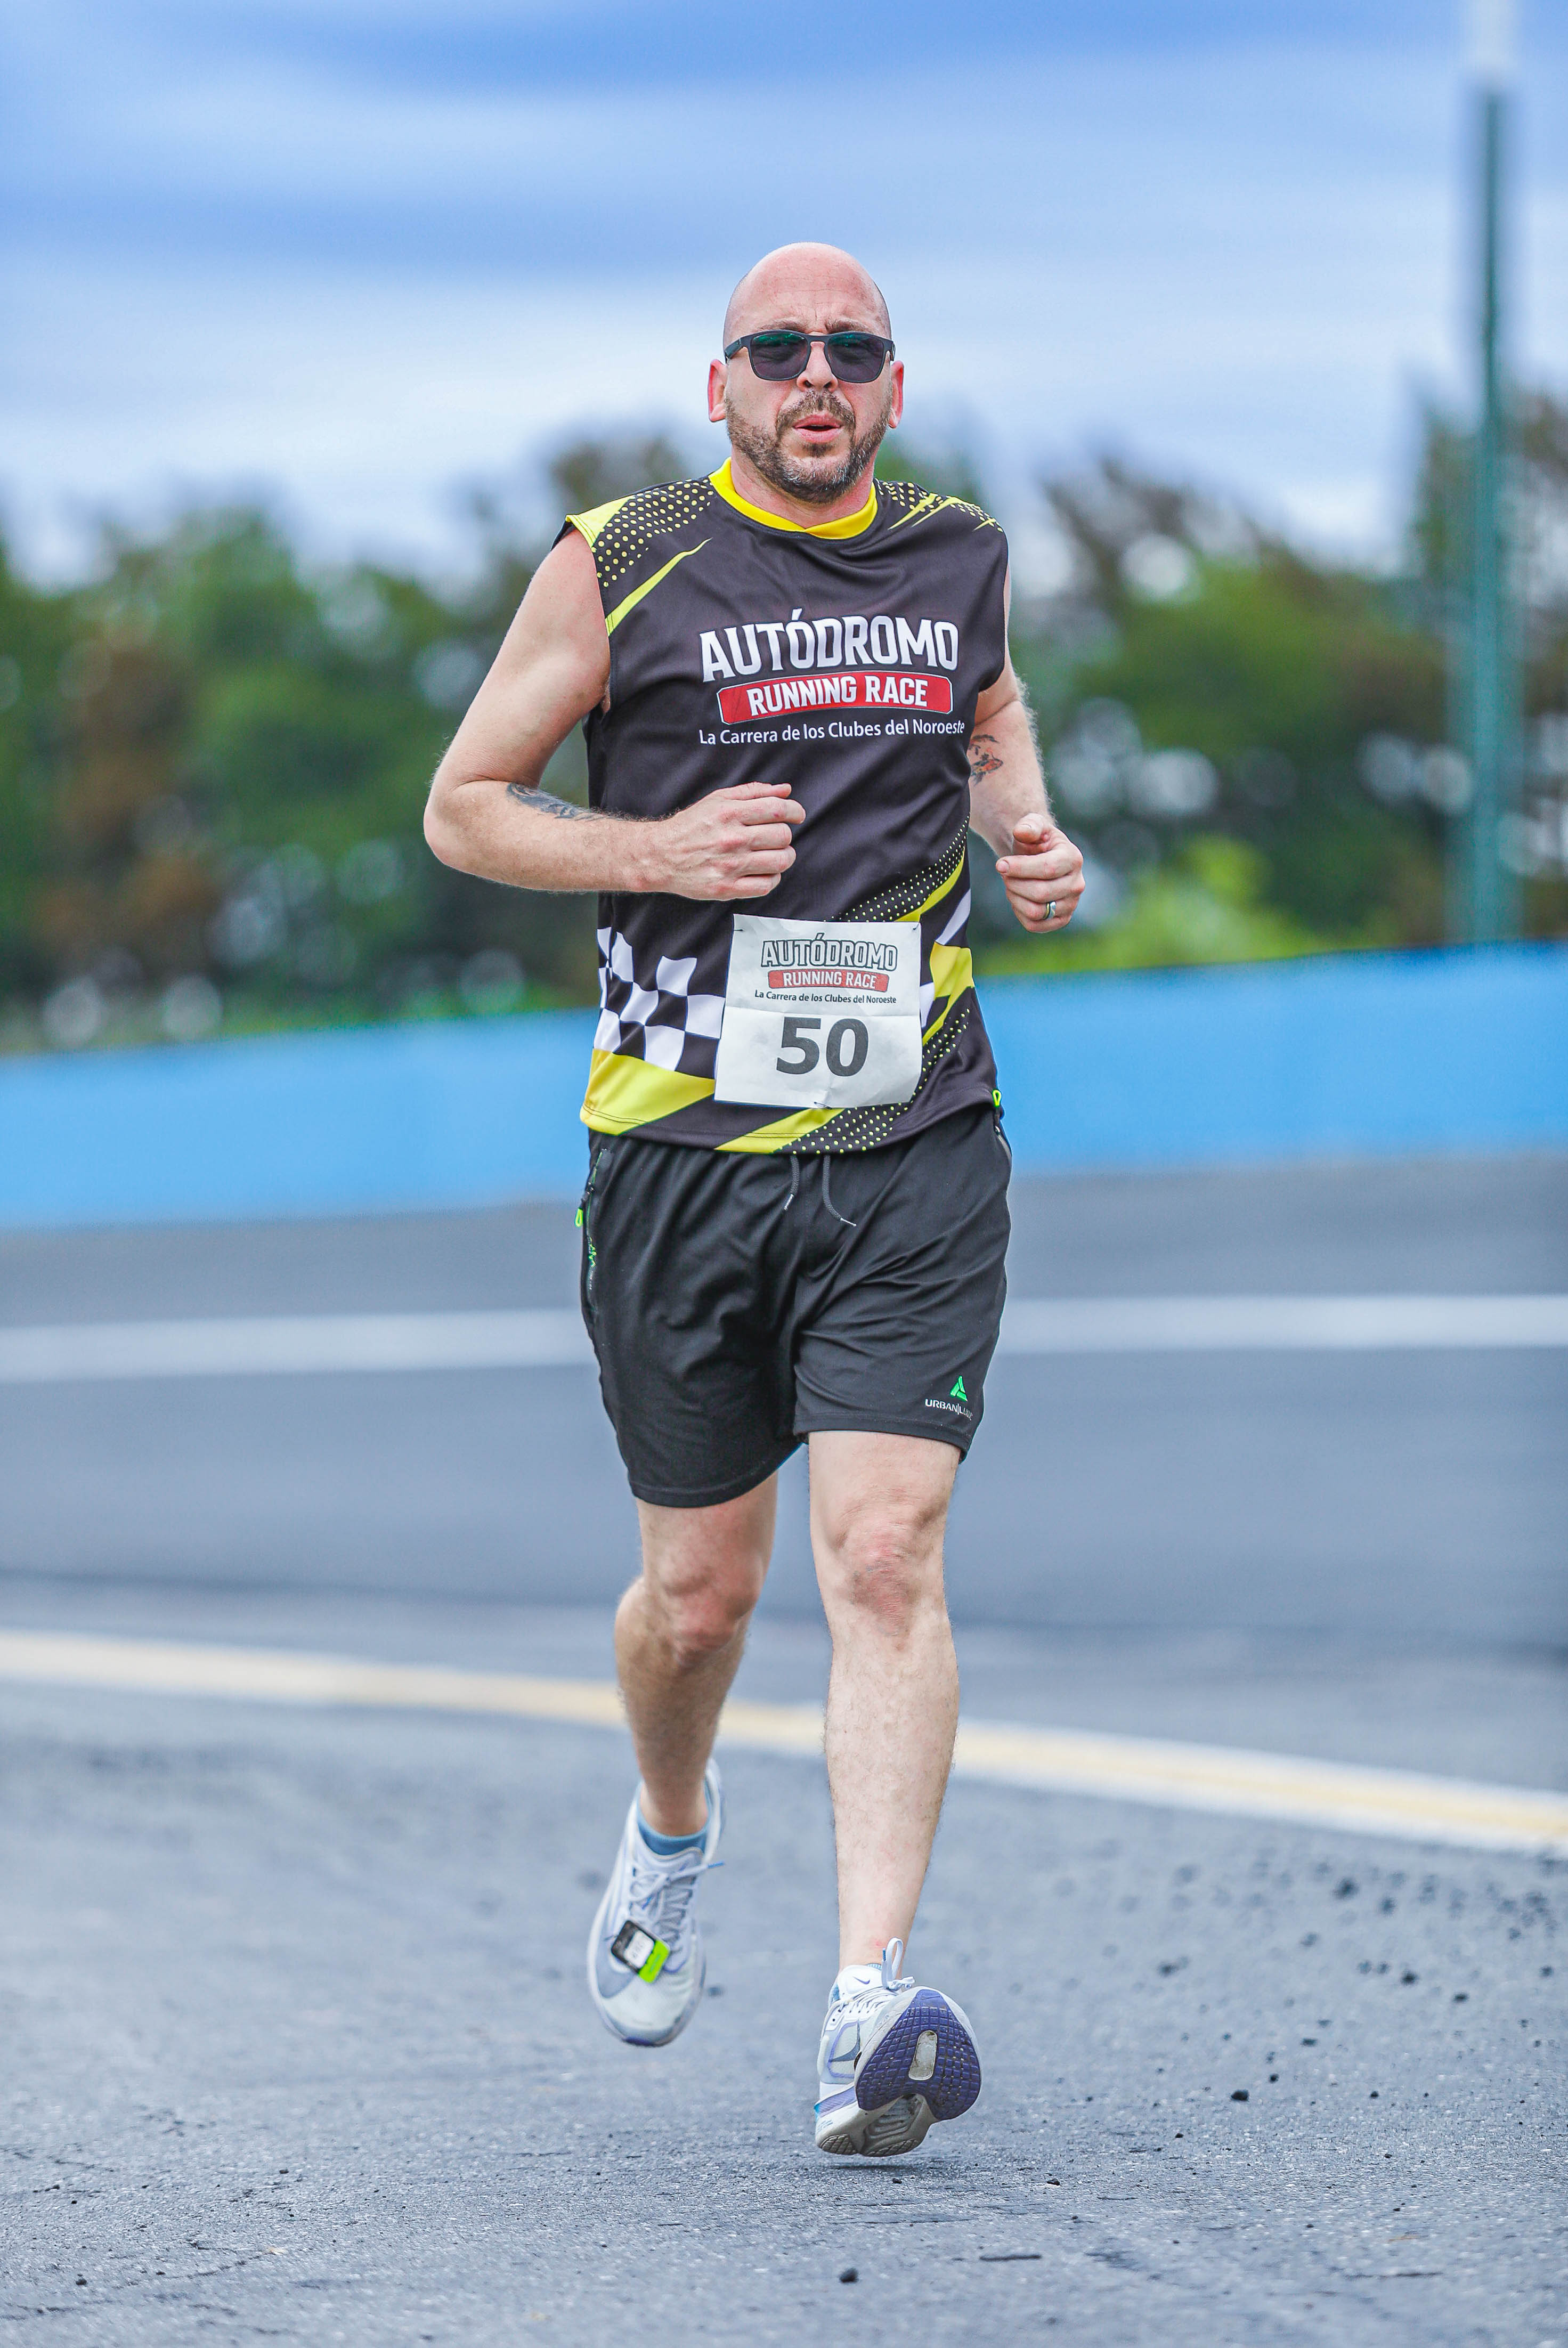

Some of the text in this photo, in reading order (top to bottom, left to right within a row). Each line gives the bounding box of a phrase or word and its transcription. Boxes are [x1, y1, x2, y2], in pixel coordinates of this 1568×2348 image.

[699, 608, 959, 683] AUTÓDROMO
[746, 676, 929, 717] RUNNING RACE
[699, 719, 965, 745] La Carrera de los Clubes del Noroeste
[760, 932, 898, 972] AUTÓDROMO
[754, 989, 897, 1004] La Carrera de los Clubes del Noroeste
[783, 971, 877, 989] RUNNING RACE
[776, 1016, 869, 1077] 50
